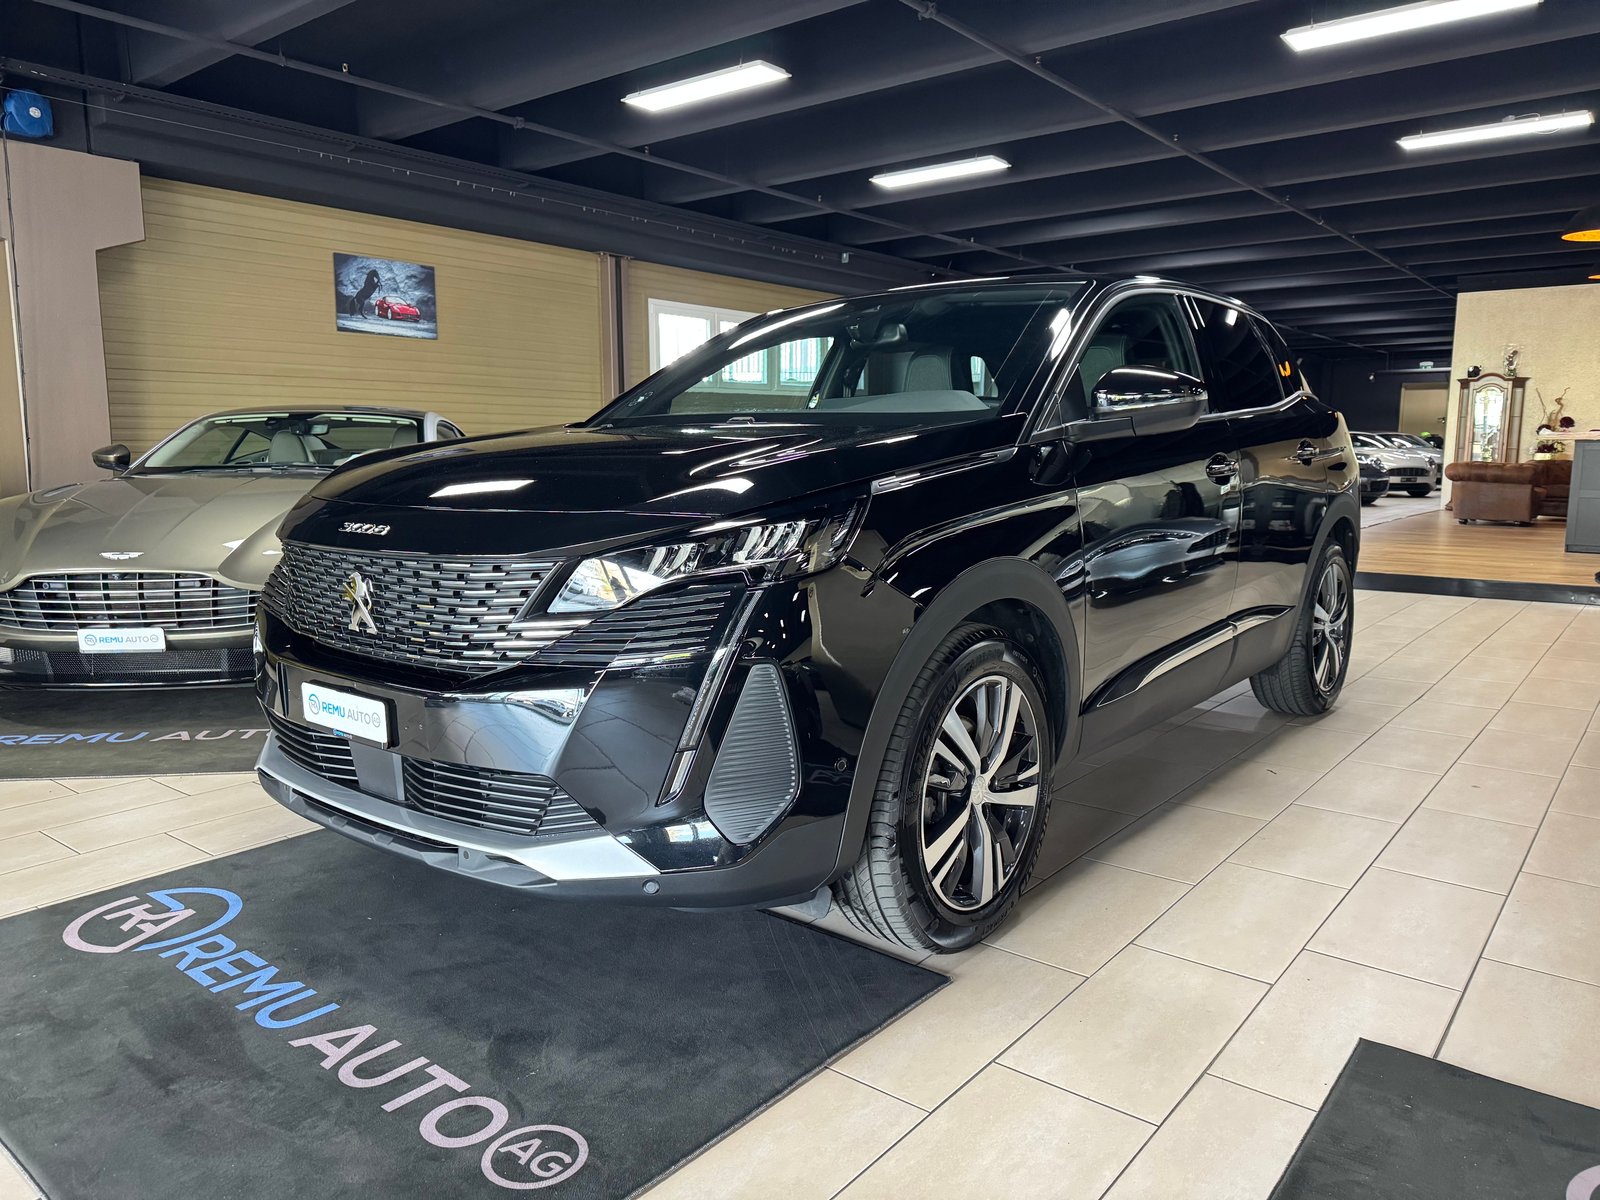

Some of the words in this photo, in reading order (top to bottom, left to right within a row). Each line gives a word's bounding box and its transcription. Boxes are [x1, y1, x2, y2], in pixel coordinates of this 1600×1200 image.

[321, 701, 346, 718] REMU
[347, 708, 371, 725] AUTO
[0, 731, 149, 746] REMU
[150, 728, 273, 742] AUT
[158, 933, 341, 1030] REMU
[288, 1024, 509, 1149] AUTO
[498, 1137, 573, 1179] AG
